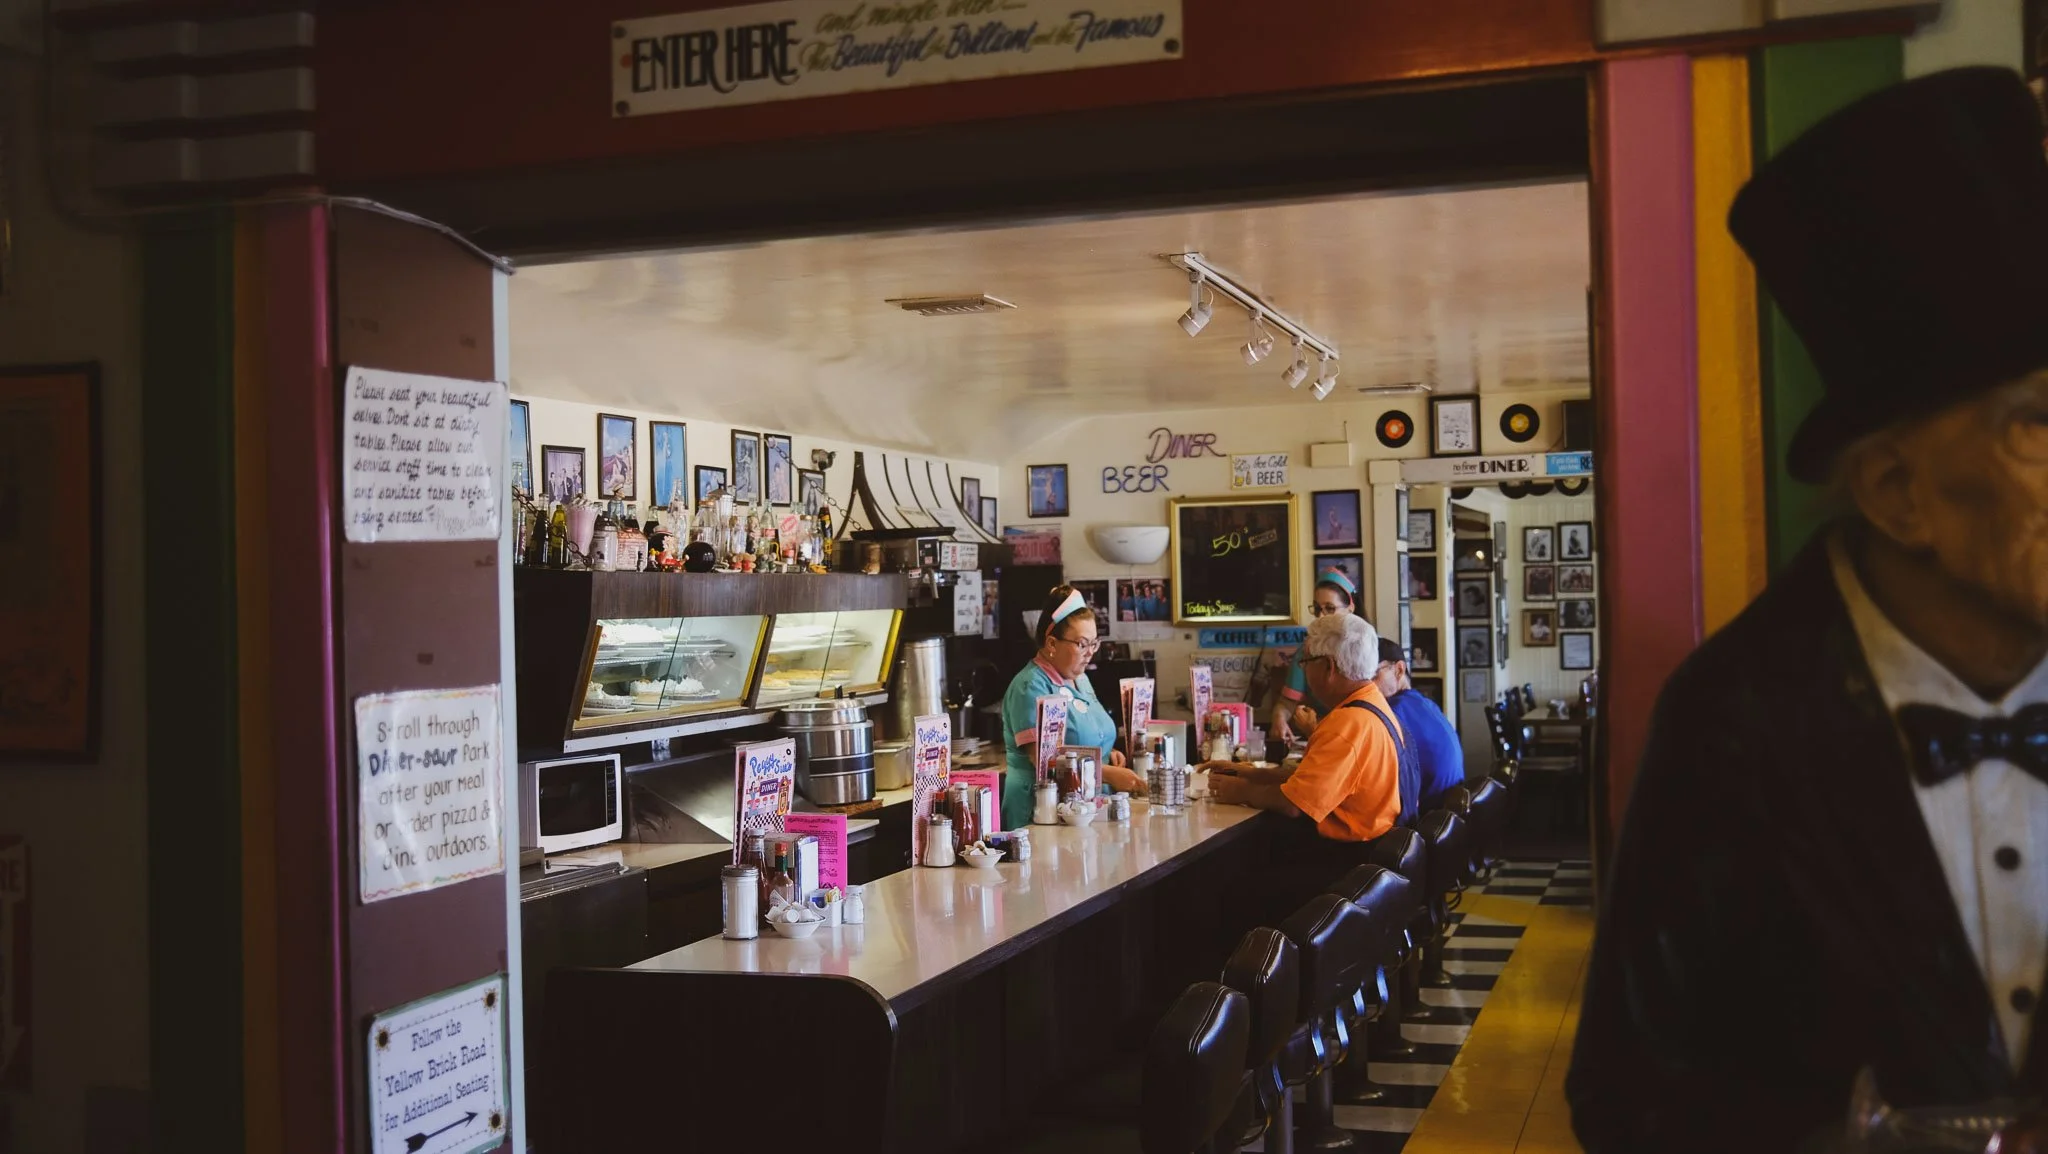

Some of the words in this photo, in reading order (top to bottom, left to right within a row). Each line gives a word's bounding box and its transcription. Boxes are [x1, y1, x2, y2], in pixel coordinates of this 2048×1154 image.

[815, 2, 866, 33] and
[631, 30, 739, 94] ENTER
[725, 20, 802, 86] HERE
[831, 25, 938, 78] Beautiful
[944, 19, 1039, 60] Brilliant
[1069, 10, 1165, 53] Famous
[354, 375, 385, 401] Please
[389, 388, 411, 401] seat
[415, 390, 437, 409] your
[440, 387, 492, 413] beautiful
[413, 411, 430, 428] sit
[434, 415, 445, 430] at
[391, 432, 422, 452] Please
[427, 437, 452, 453] allow
[1146, 427, 1227, 464] DINER
[353, 457, 391, 473] service
[396, 458, 422, 482] staff
[427, 461, 447, 477] time
[451, 462, 462, 477] to
[1268, 455, 1288, 468] Cold
[1479, 459, 1530, 473] DINER
[1102, 464, 1170, 494] BEER
[1257, 470, 1284, 486] BEER
[354, 482, 375, 500] and
[378, 482, 422, 500] sanitize
[427, 485, 456, 500] tables
[461, 484, 493, 509] befor
[1184, 600, 1216, 617] Today's
[1214, 631, 1258, 645] COFFEE
[377, 714, 421, 743] Sroll
[428, 709, 480, 739] through
[463, 741, 490, 764] Park
[424, 778, 453, 805] your
[761, 782, 778, 792] DINER
[374, 823, 392, 841] or
[401, 811, 437, 836] rder
[442, 804, 478, 834] pizza
[481, 799, 491, 821] &
[426, 834, 491, 862] outdoors.
[411, 1027, 443, 1052] Follow
[445, 1019, 462, 1037] the
[385, 1070, 424, 1097] Yellow
[427, 1051, 458, 1080] Brick
[460, 1037, 487, 1066] Road
[384, 1112, 399, 1132] for
[403, 1085, 453, 1124] Additional
[456, 1074, 489, 1100] Seating
